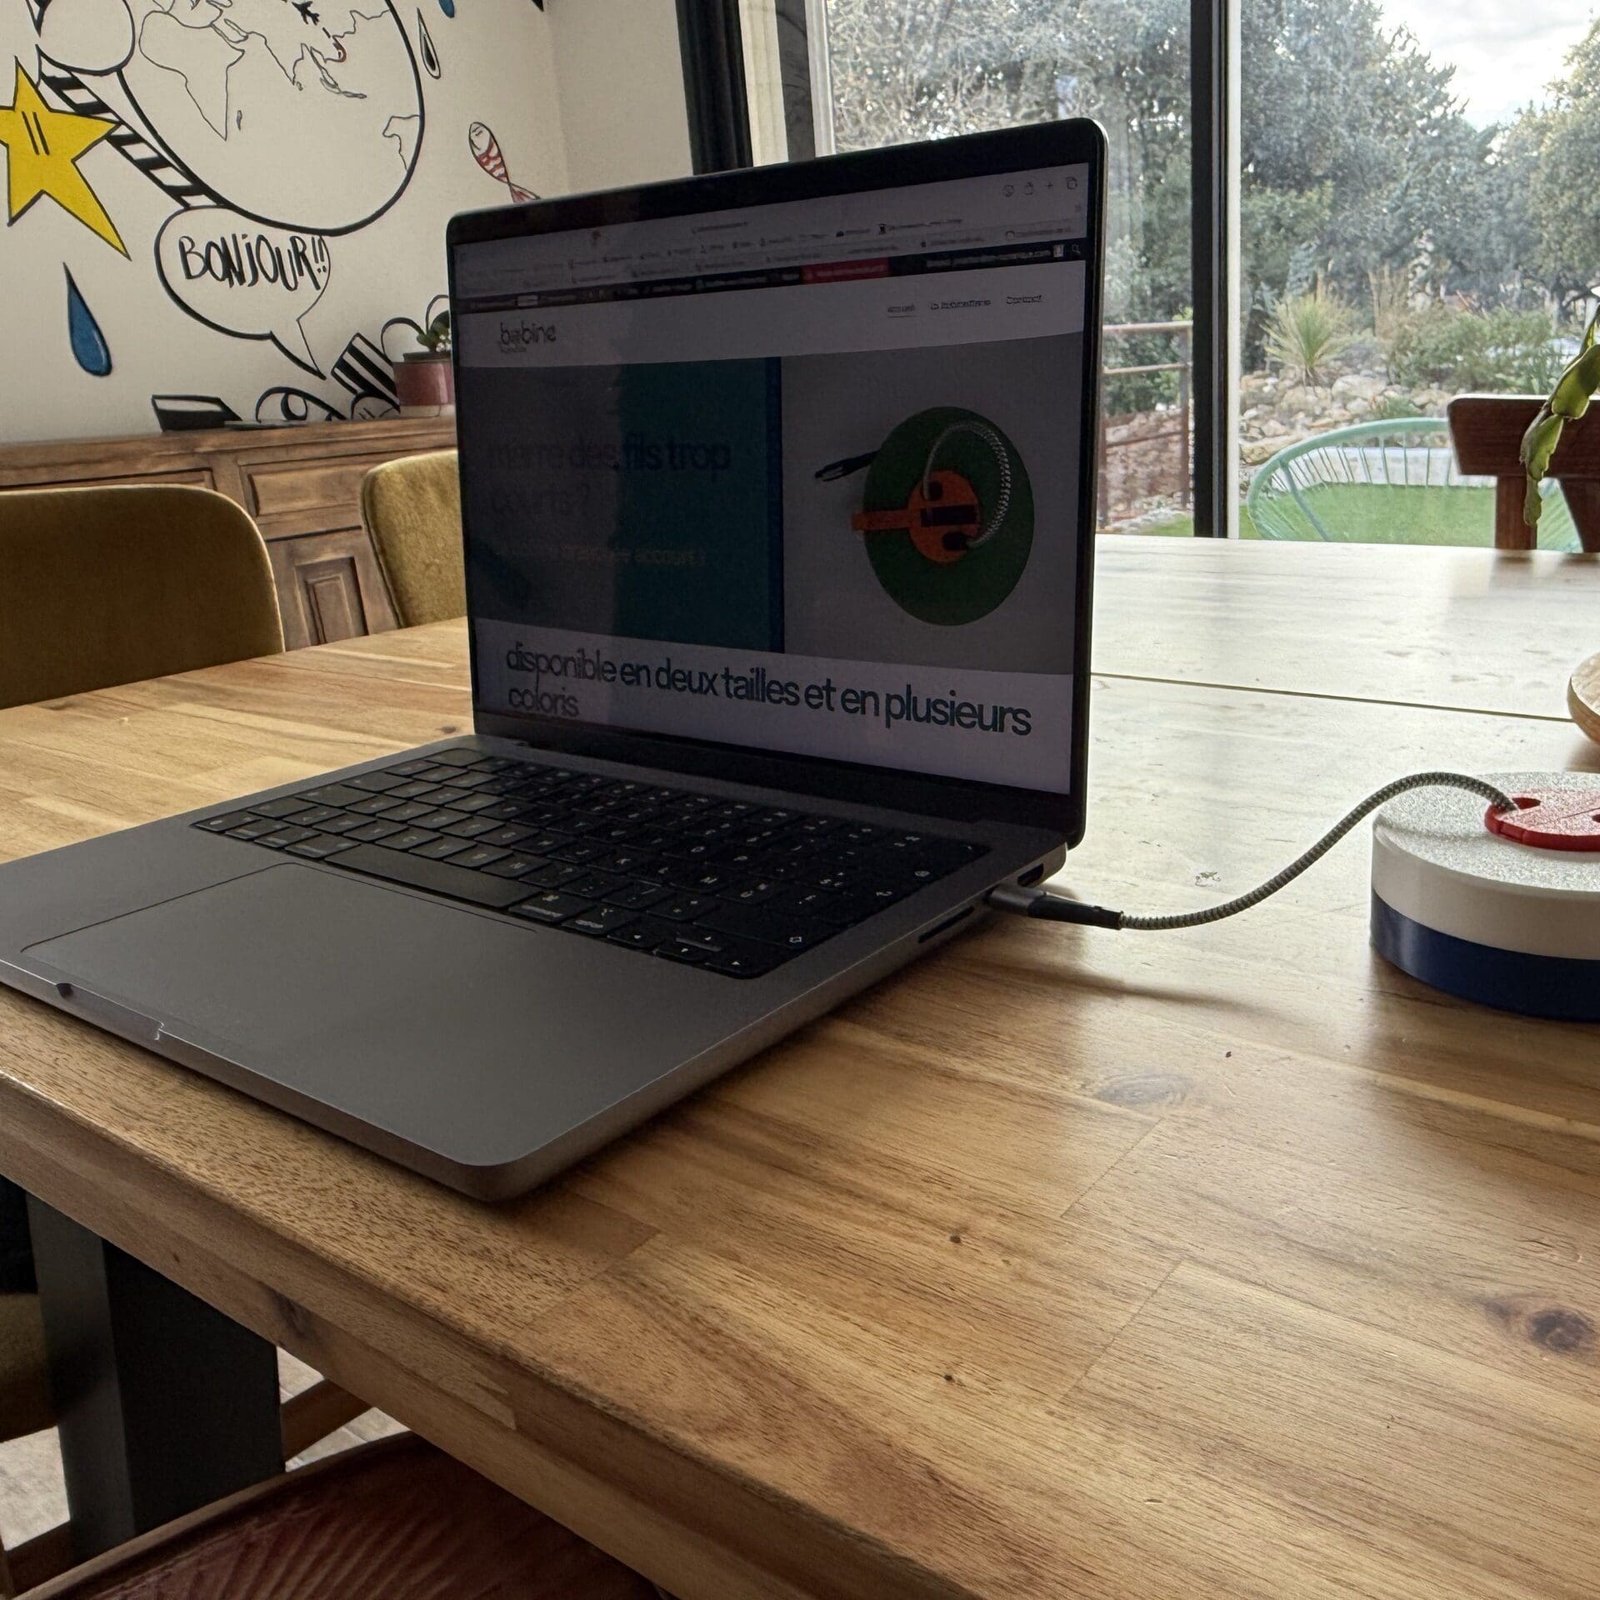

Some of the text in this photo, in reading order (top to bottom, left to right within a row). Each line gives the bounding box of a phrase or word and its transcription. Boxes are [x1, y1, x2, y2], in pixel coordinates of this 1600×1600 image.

[621, 432, 663, 470] fils
[665, 434, 732, 482] trop
[506, 641, 1032, 737] disponible en deux tailles et en plusieurs
[508, 687, 580, 717] coloris
